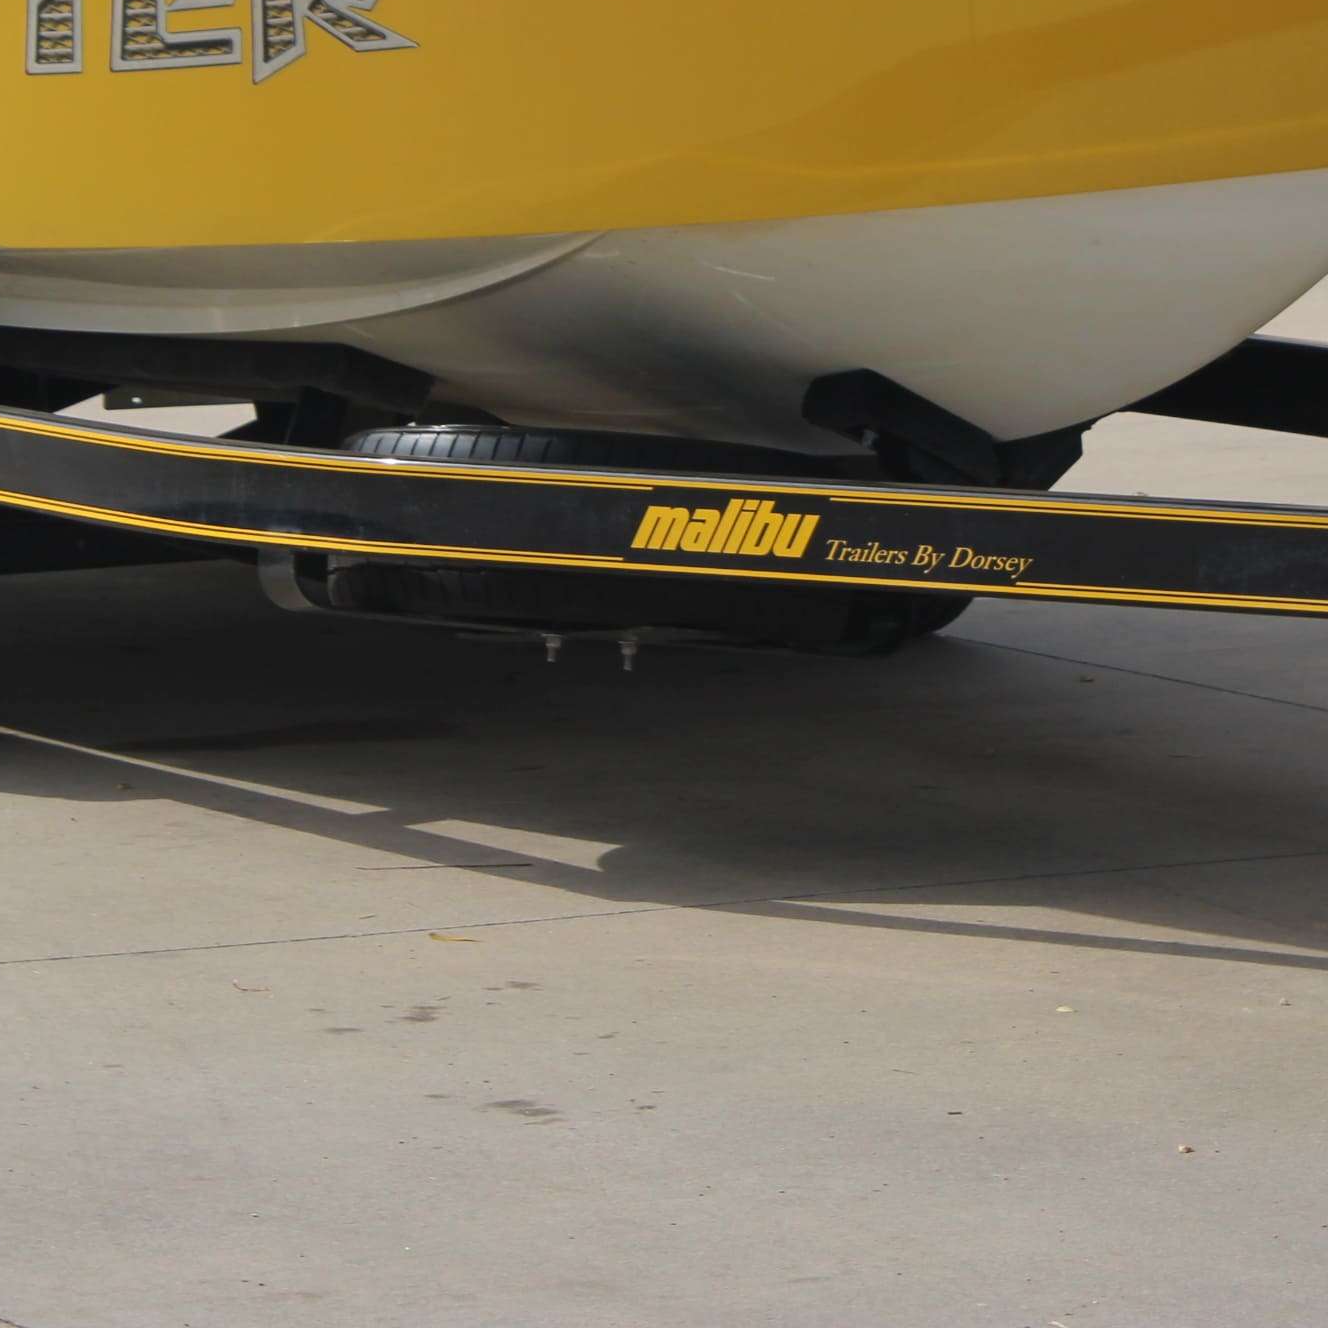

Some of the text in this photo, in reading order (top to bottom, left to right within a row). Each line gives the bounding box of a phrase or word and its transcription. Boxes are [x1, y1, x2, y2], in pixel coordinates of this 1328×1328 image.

[630, 498, 821, 559] malibu
[825, 539, 1034, 579] Trailers By Dorsey
